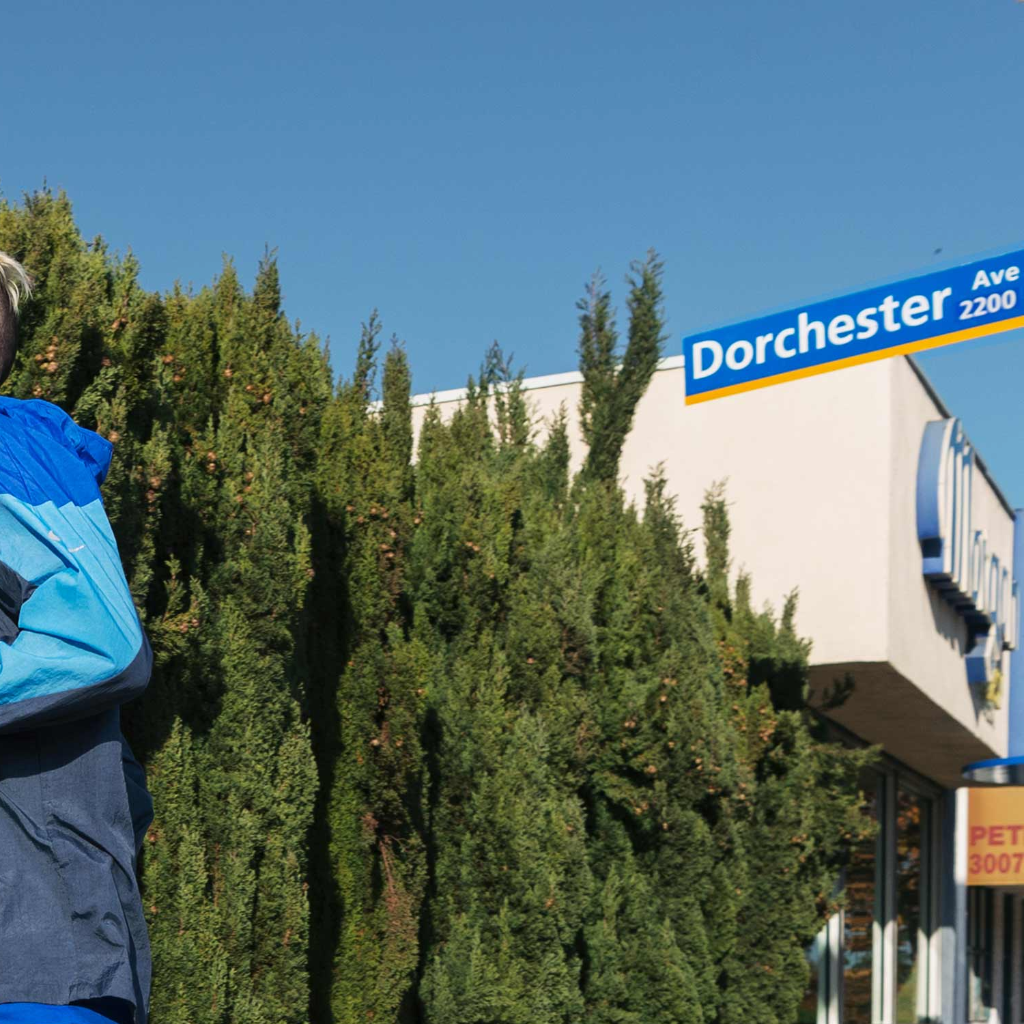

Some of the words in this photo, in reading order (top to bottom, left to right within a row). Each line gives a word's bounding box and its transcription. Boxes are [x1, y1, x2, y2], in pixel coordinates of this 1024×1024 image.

[959, 289, 1017, 321] 2200
[692, 287, 952, 380] Dorchester
[971, 265, 1021, 291] Ave
[970, 852, 1024, 875] 3007
